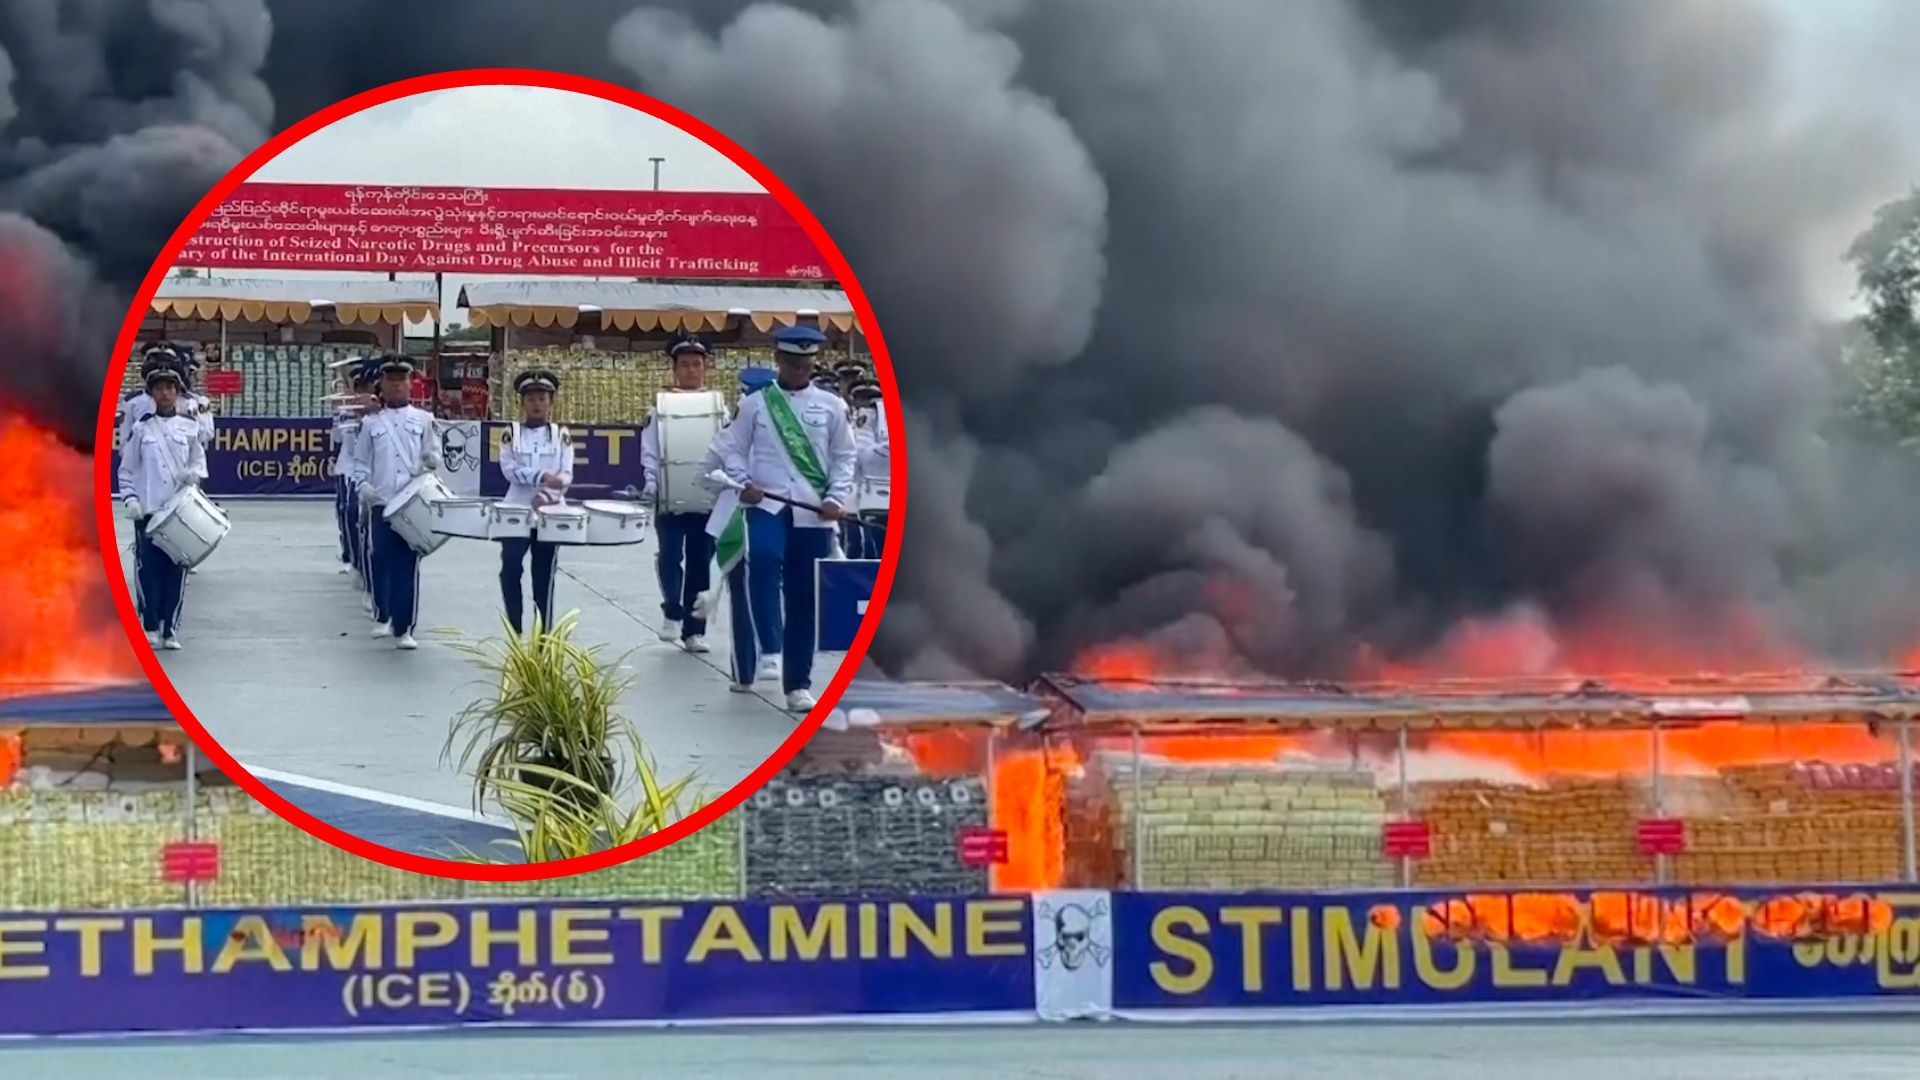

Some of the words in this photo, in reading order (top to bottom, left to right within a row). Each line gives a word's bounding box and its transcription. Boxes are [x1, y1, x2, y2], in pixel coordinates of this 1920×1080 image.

[269, 235, 286, 248] of
[289, 235, 342, 249] Seized
[347, 237, 416, 251] Narcotic
[422, 239, 471, 254] Drugs
[476, 240, 506, 253] and
[512, 241, 600, 255] Precursors
[609, 242, 636, 255] for
[639, 243, 664, 256] the
[210, 248, 229, 260] of
[232, 248, 258, 260] the
[263, 249, 370, 264] International
[376, 252, 406, 266] Day
[412, 253, 475, 268] Against
[480, 254, 522, 269] Drug
[527, 256, 578, 269] Abuse
[583, 257, 612, 269] and
[619, 257, 661, 269] Illicit
[666, 257, 759, 272] Trafficking
[237, 460, 283, 480] (ICE)
[342, 972, 471, 1016] (ICE)
